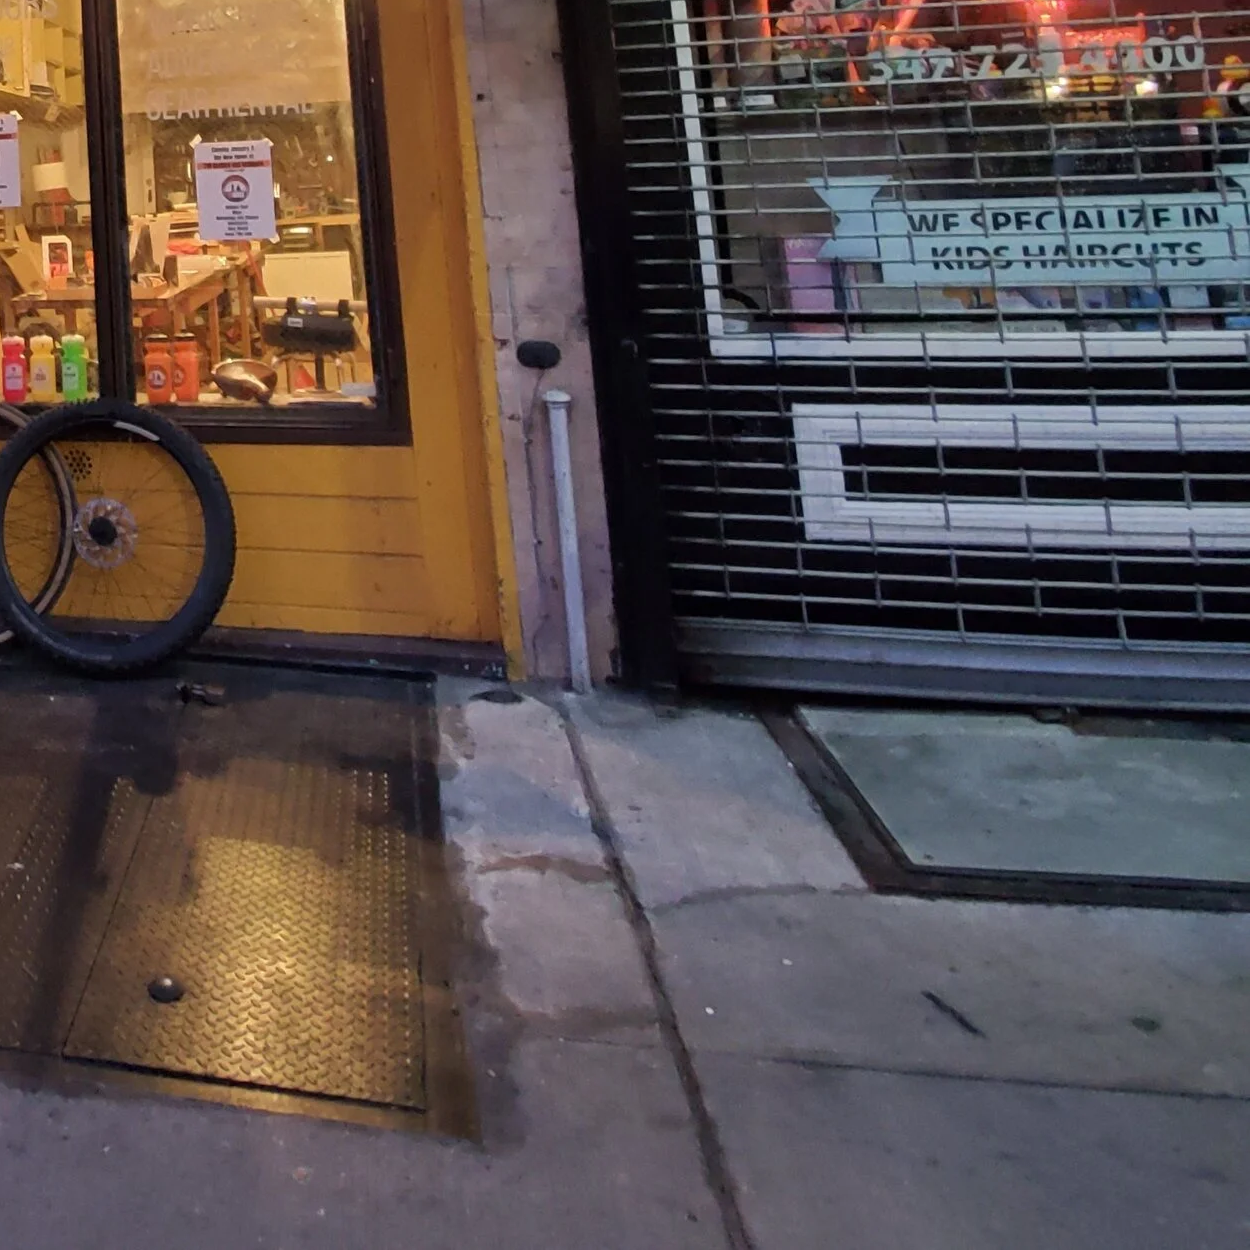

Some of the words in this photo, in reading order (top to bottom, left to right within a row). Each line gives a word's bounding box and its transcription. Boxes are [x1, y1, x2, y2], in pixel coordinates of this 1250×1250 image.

[906, 212, 960, 233] WE
[1181, 205, 1220, 228] IN
[930, 244, 1014, 271] KIDS
[1021, 241, 1207, 268] HAIRCUTS
